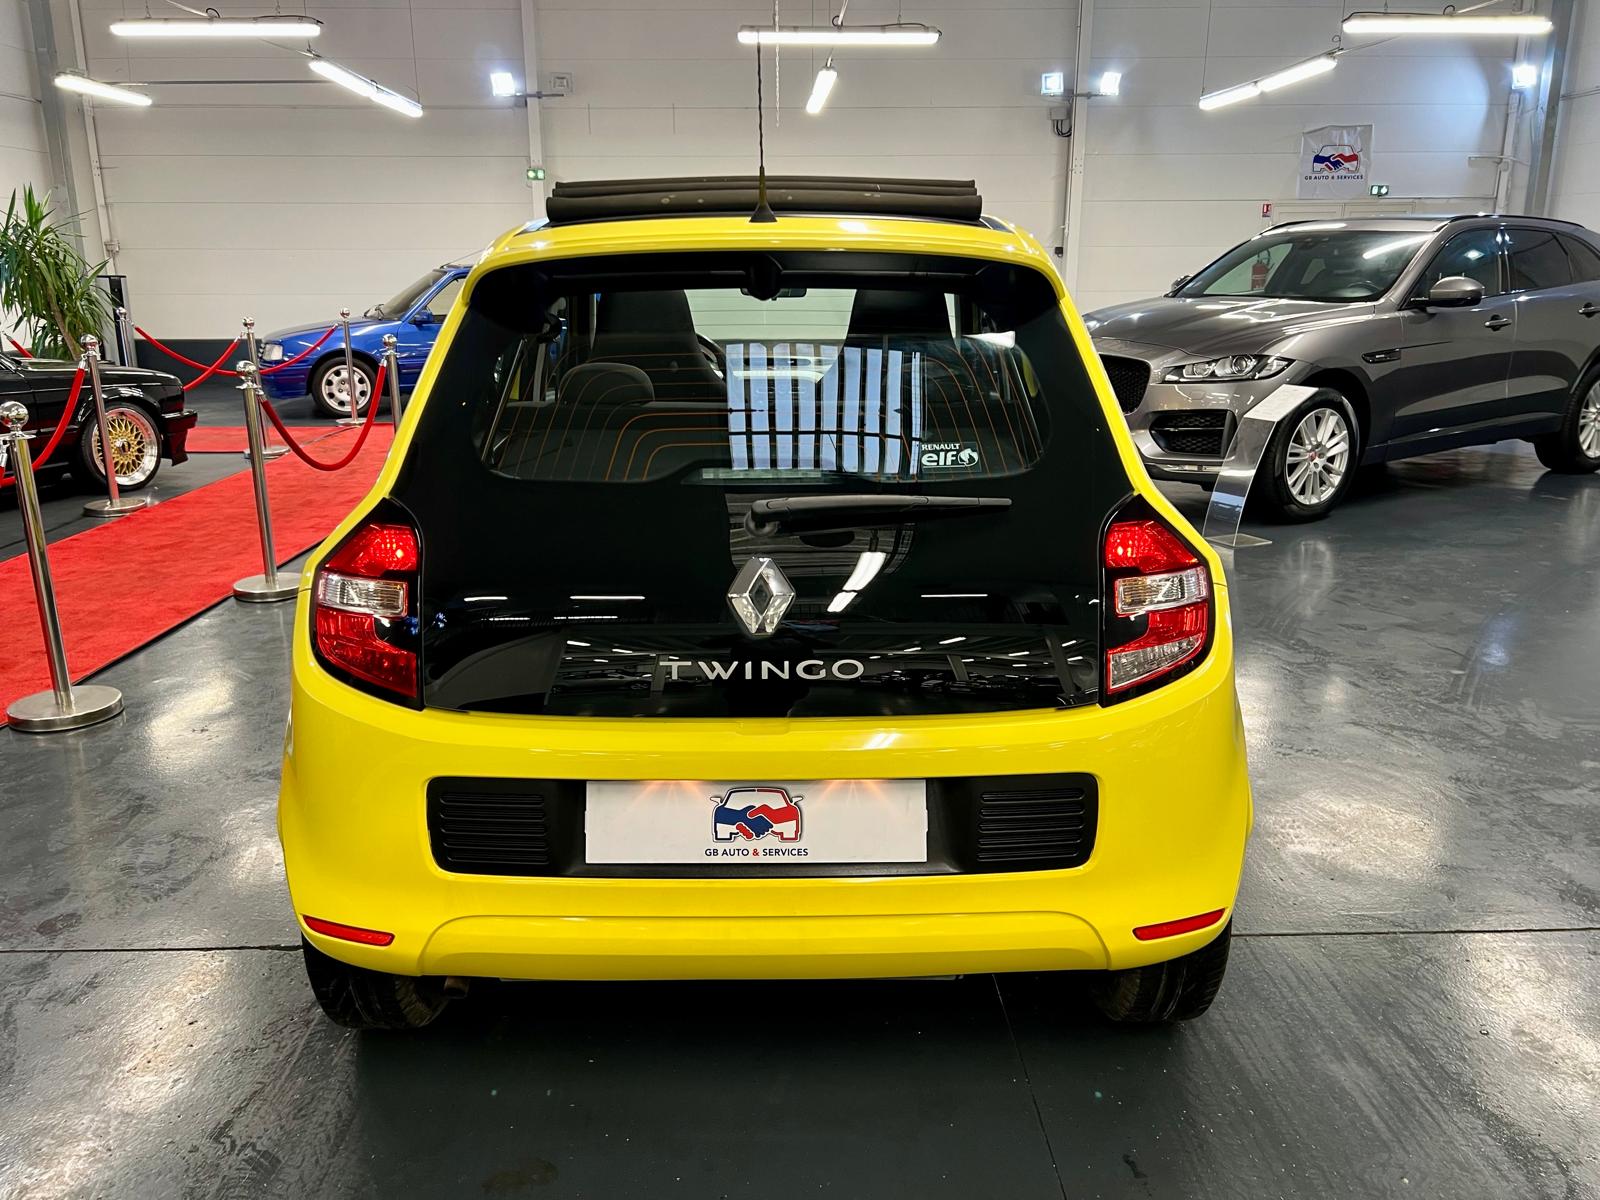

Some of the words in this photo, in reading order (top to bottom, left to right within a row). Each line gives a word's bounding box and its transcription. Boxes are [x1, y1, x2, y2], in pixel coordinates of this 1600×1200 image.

[921, 443, 961, 451] RENAULT
[921, 451, 957, 466] elf
[659, 659, 865, 680] TWINGO
[704, 848, 719, 857] GB
[721, 848, 750, 857] AUTO
[752, 848, 760, 857] &
[762, 848, 809, 857] SERVICES
